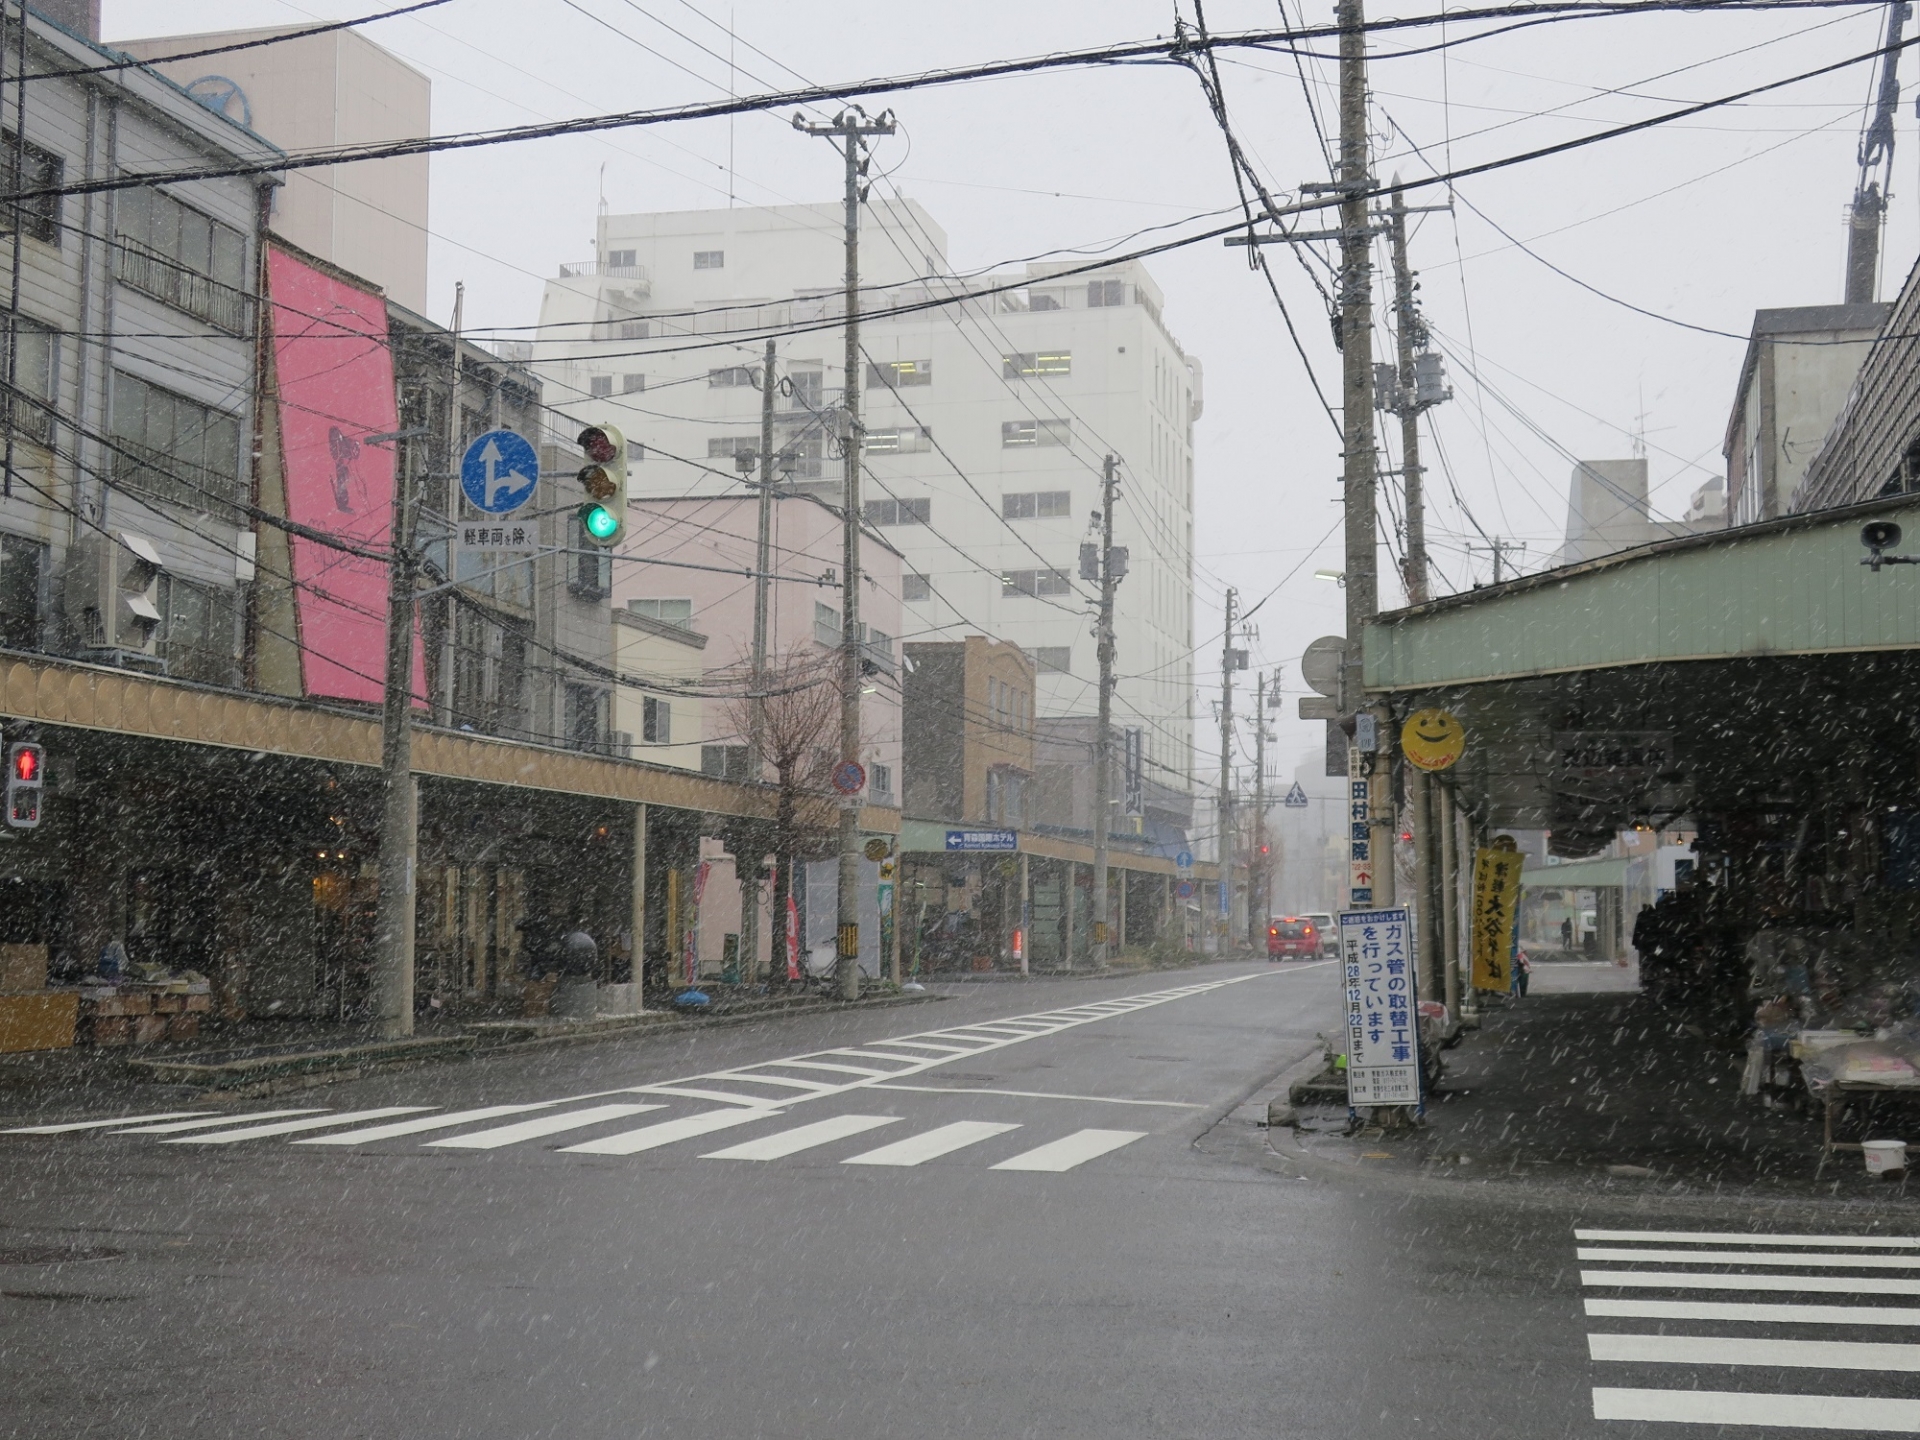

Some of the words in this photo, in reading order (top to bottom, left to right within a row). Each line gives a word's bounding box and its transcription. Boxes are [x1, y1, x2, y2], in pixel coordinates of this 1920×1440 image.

[464, 527, 532, 546] 軽車両を除く
[1342, 913, 1405, 924] ご迷惑をおかけします
[1346, 939, 1364, 1063] 平成28年12月22日まで
[1362, 926, 1385, 1044] を行っています
[1386, 924, 1411, 1062] ガス管の取替工事
